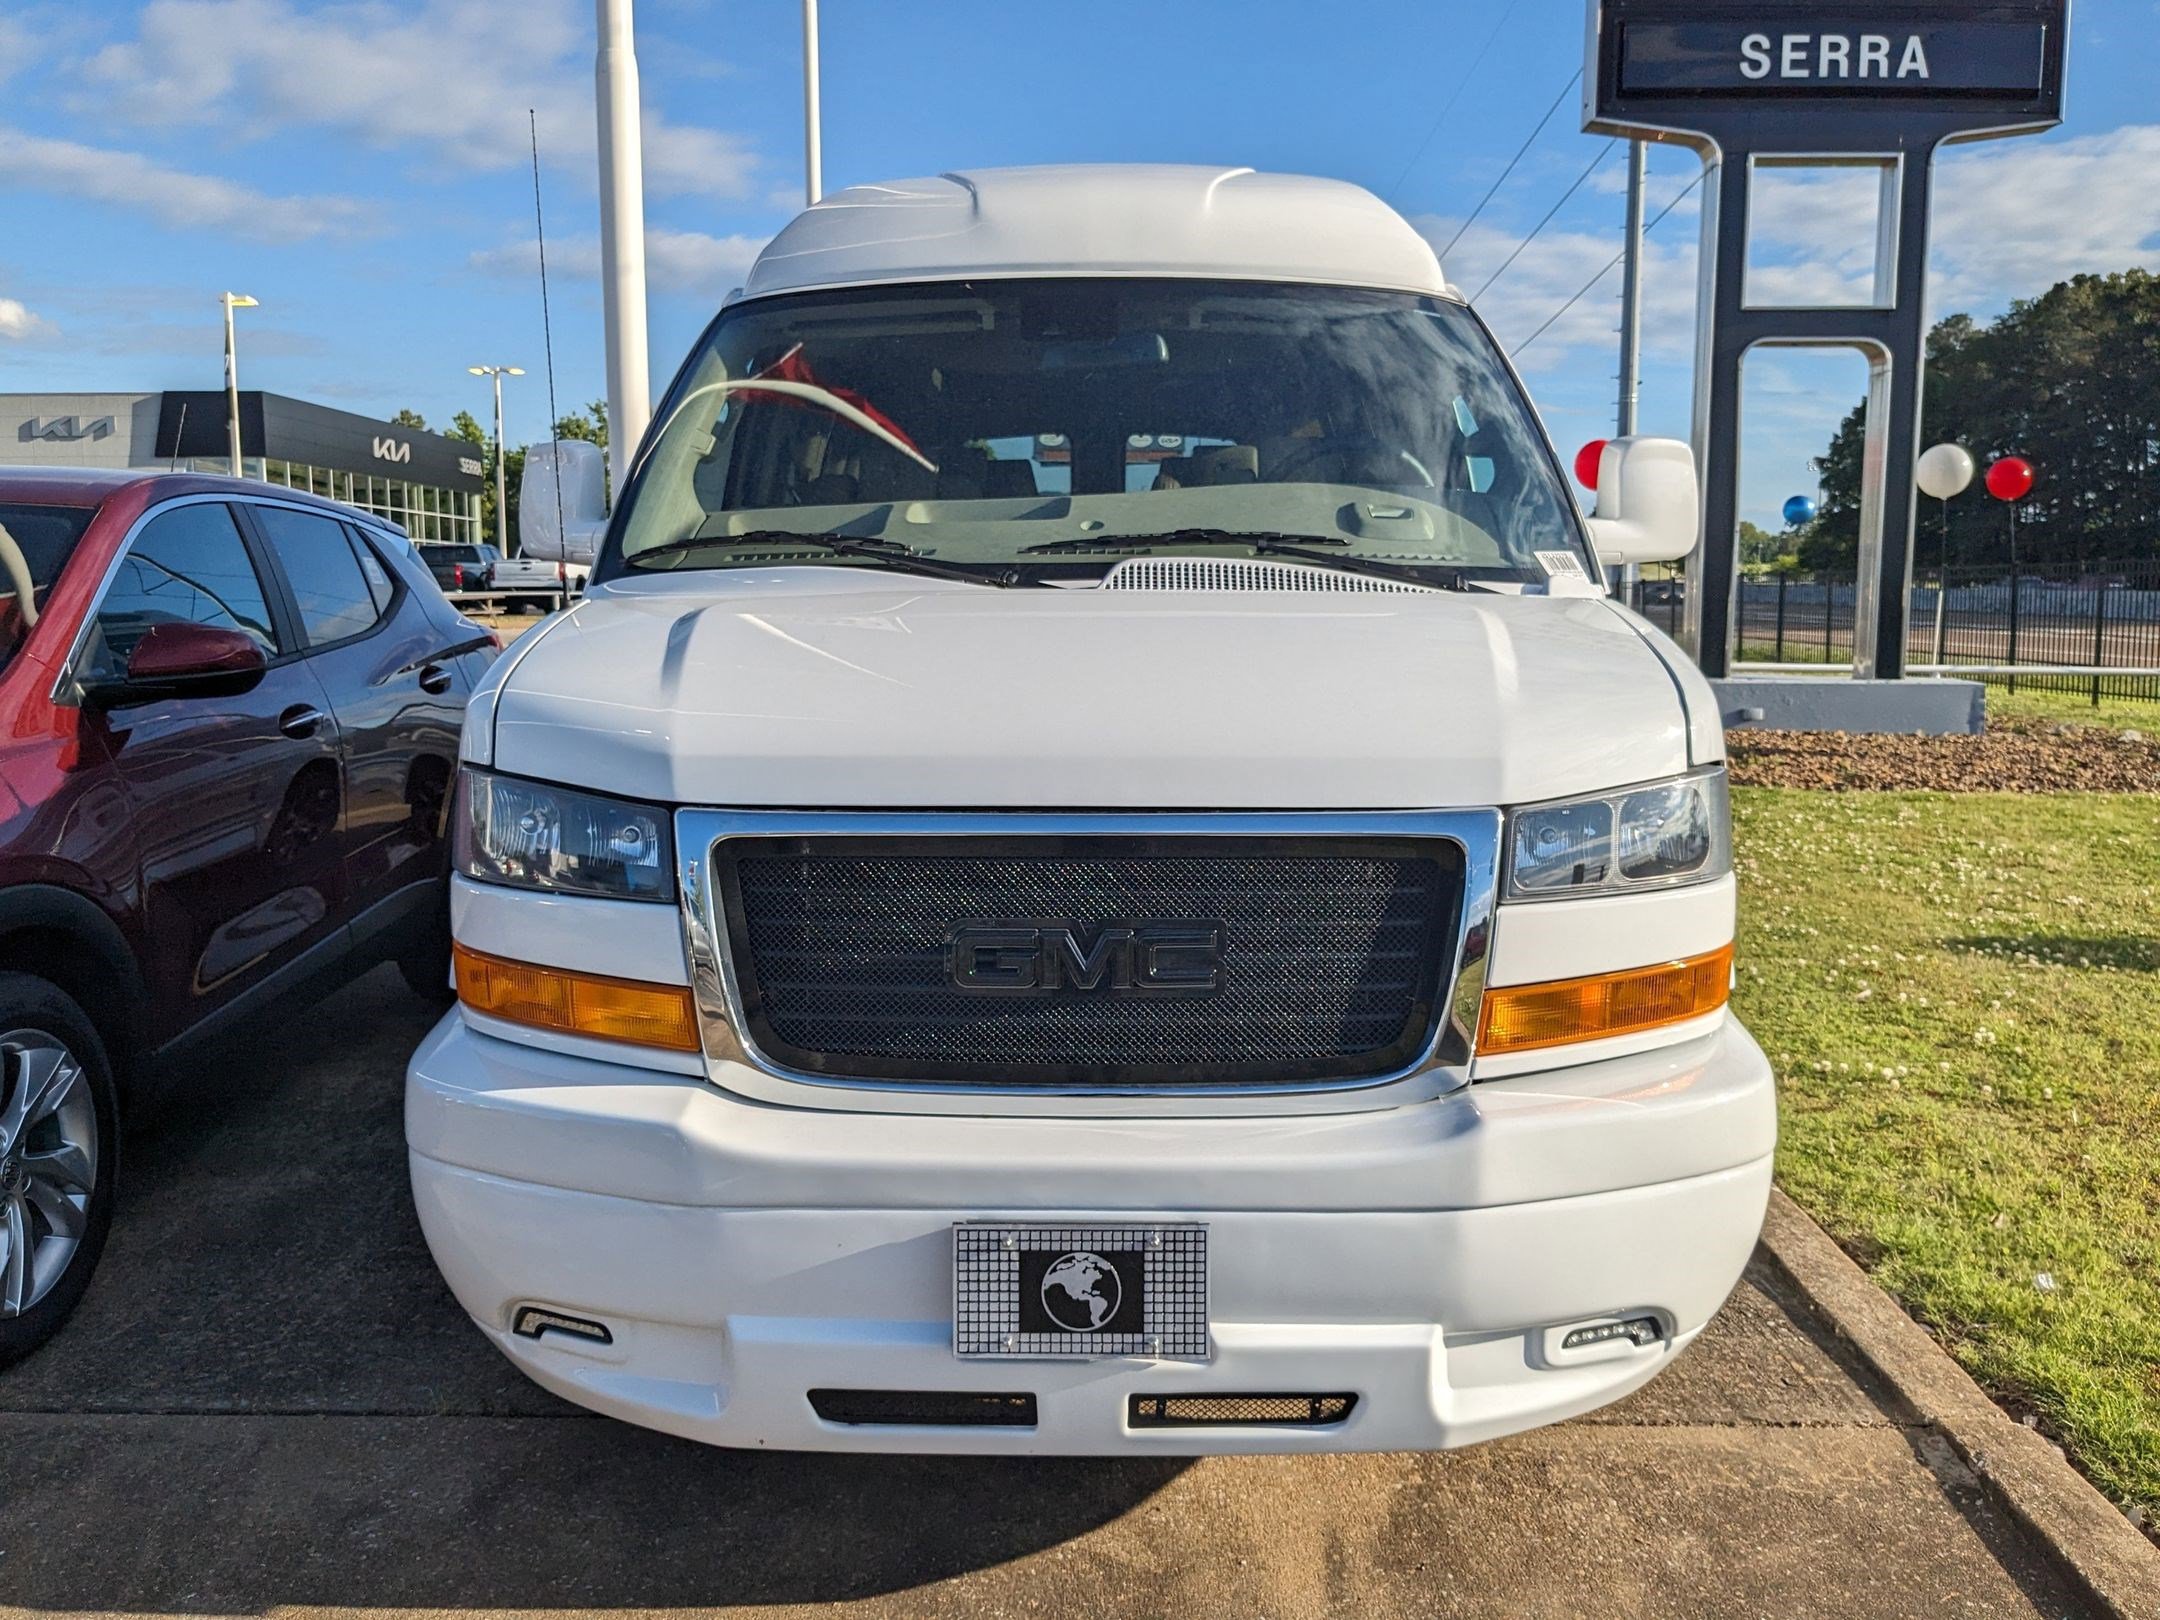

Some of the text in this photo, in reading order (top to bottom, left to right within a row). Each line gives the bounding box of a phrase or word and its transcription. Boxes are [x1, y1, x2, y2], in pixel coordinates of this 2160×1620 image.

[1739, 33, 1929, 79] SERRA
[373, 436, 411, 464] KIA
[953, 927, 1220, 991] GMC
